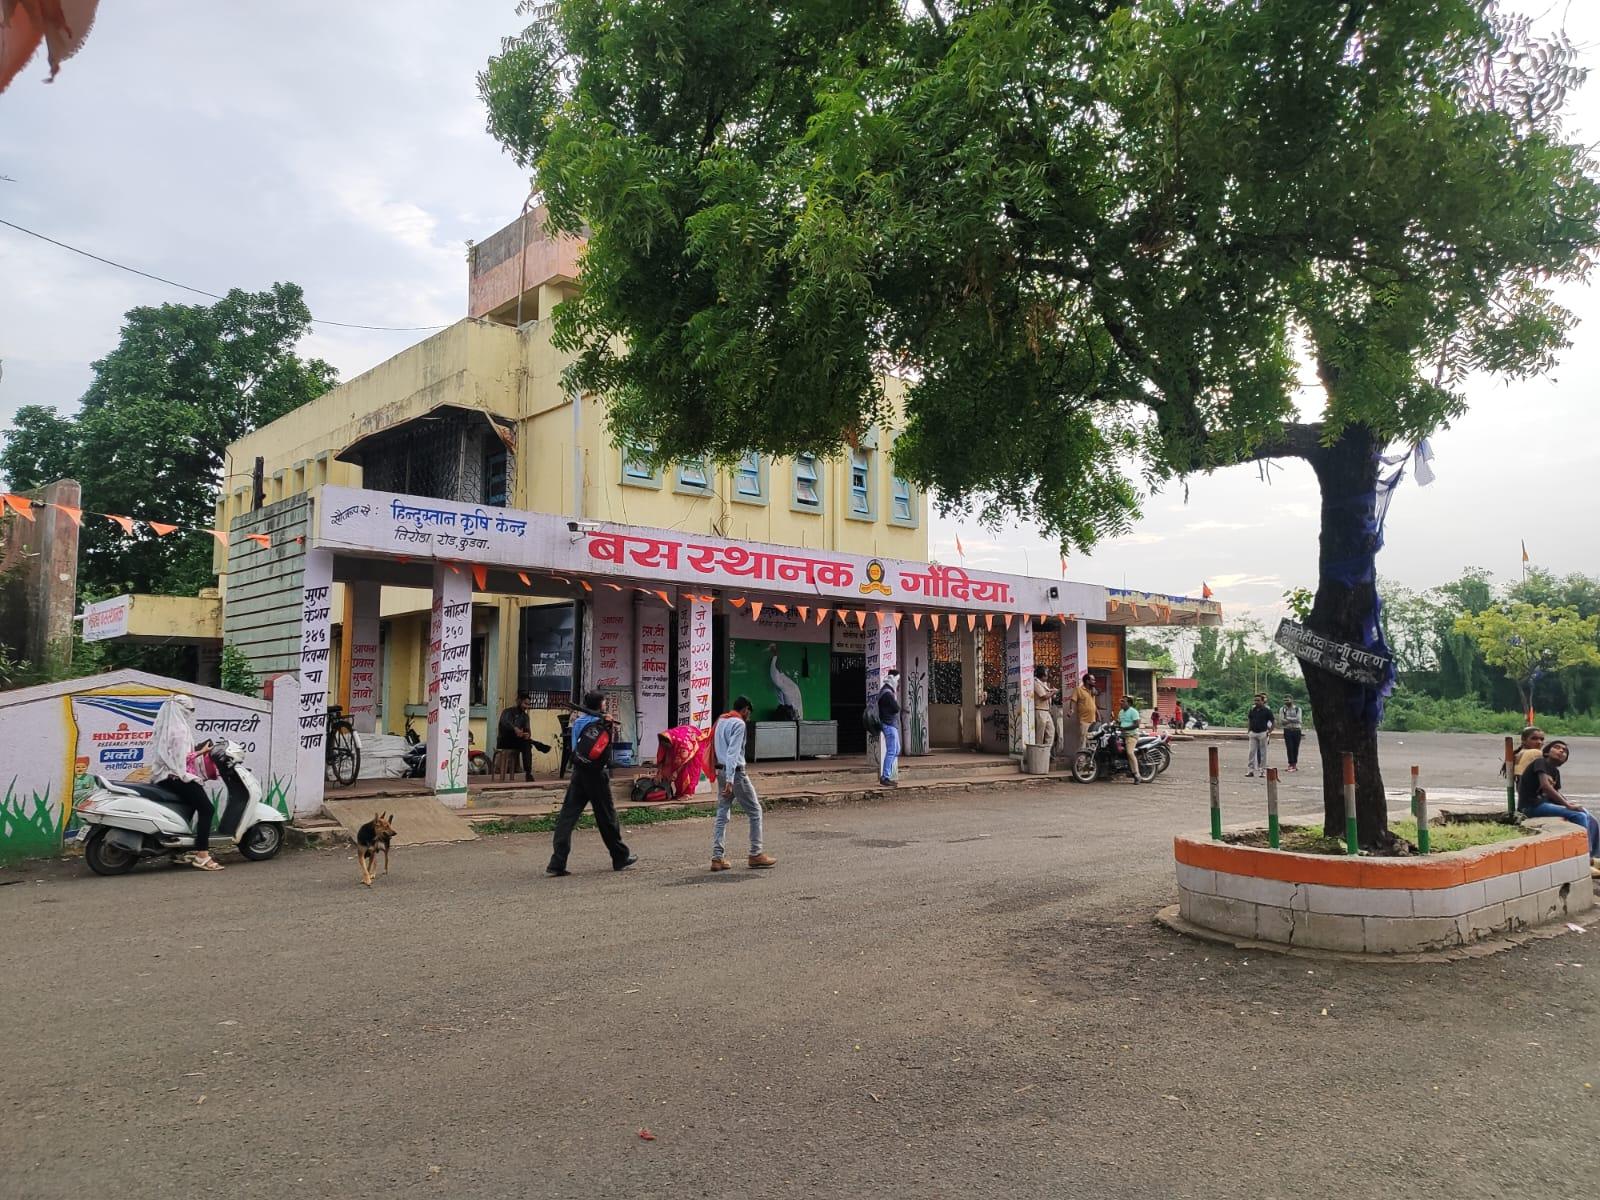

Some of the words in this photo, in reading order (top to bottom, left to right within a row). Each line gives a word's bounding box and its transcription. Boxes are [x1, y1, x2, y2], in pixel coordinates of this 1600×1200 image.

[390, 499, 457, 529] हिन्दुस्तान
[460, 509, 493, 535] कृषि
[495, 513, 527, 538] केन्द्र
[394, 526, 431, 544] तिरोडा
[899, 564, 1015, 604] गोंदिया.
[695, 605, 707, 621] जे
[694, 622, 707, 638] पी
[304, 670, 323, 684] चा
[195, 714, 261, 734] कालावधी
[300, 733, 323, 750] धान
